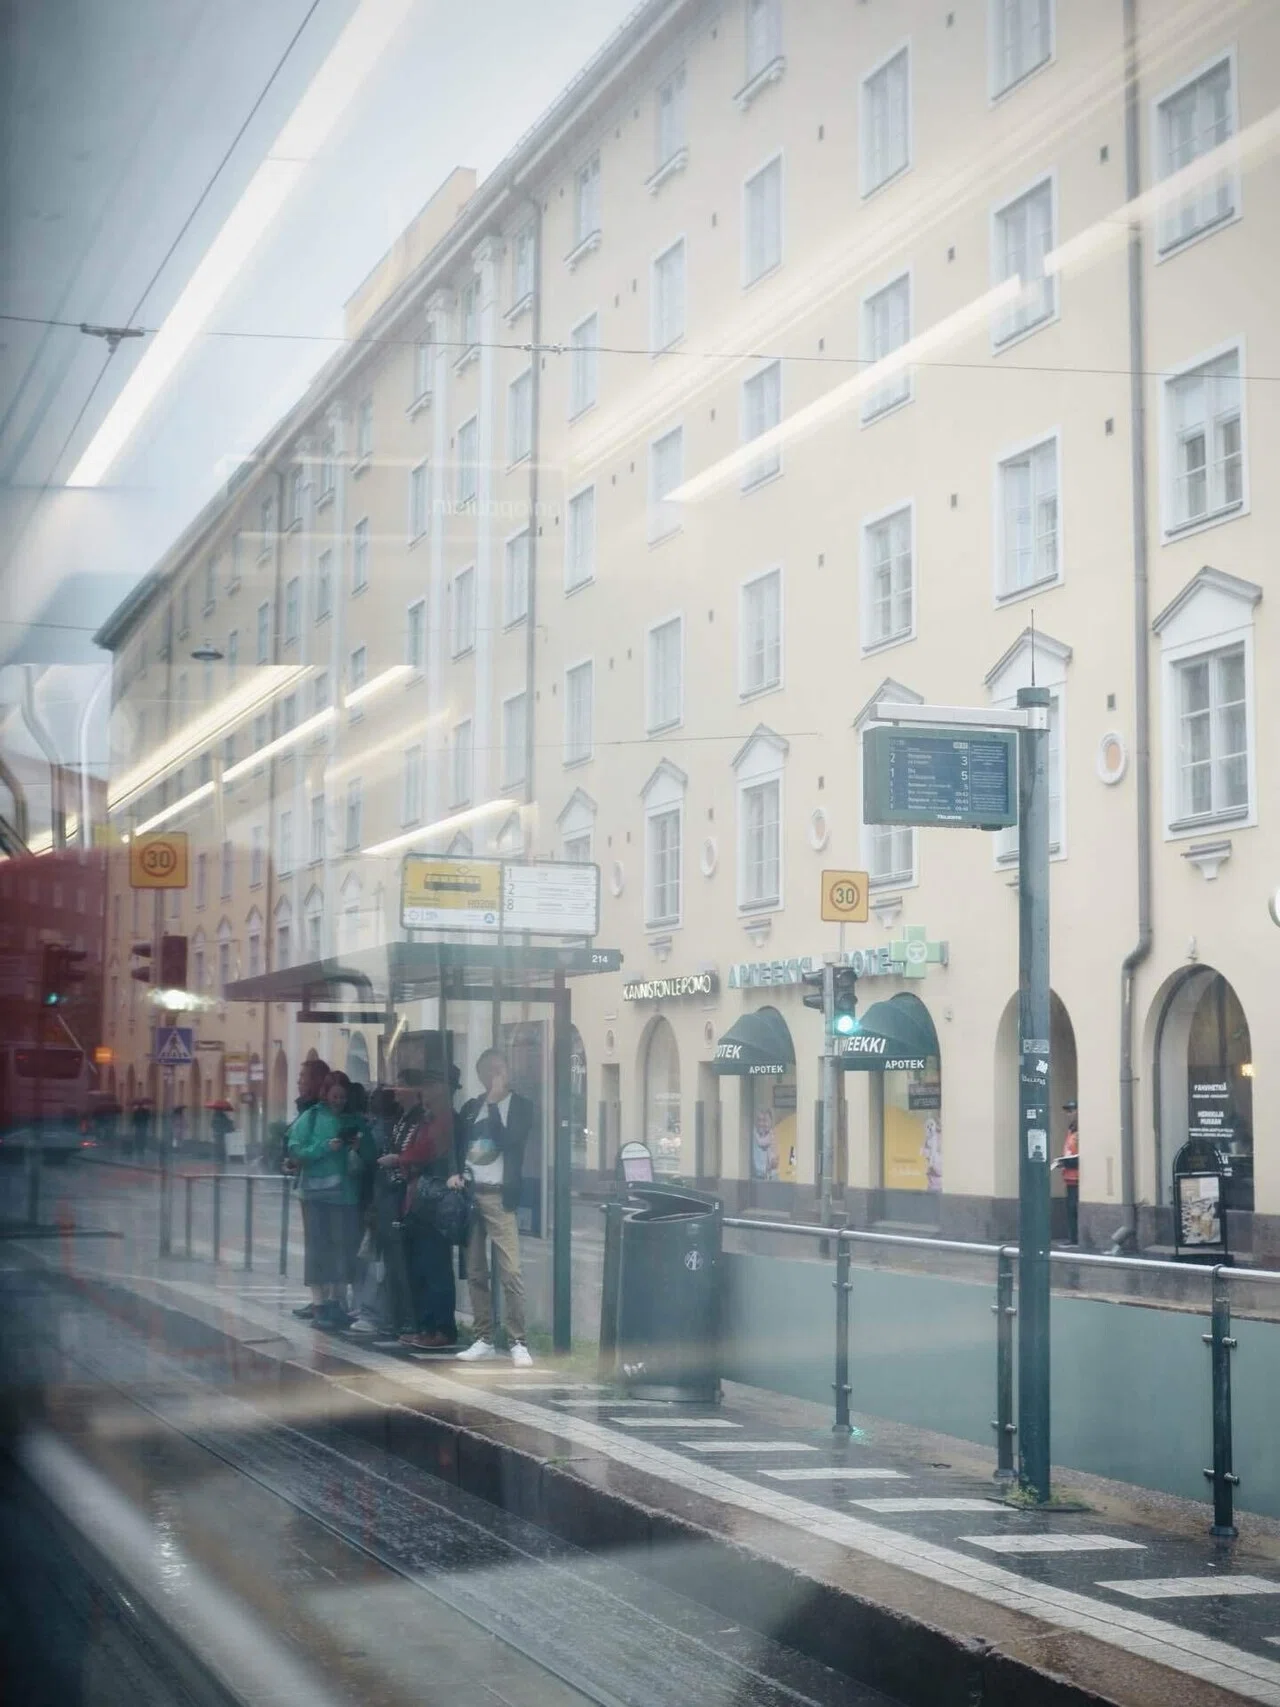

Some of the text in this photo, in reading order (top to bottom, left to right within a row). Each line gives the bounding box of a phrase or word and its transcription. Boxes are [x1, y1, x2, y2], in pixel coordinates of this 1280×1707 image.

[889, 753, 896, 763] 2
[961, 756, 968, 766] 3
[889, 768, 895, 778] 1
[961, 771, 968, 781] 5
[147, 850, 170, 869] 30
[507, 868, 512, 880] 1
[507, 883, 515, 895] 2
[835, 887, 855, 904] 30
[506, 898, 514, 911] 8
[592, 954, 608, 963] 214
[728, 956, 814, 988] APTEEKK
[715, 1044, 742, 1059] OTEK
[749, 1065, 784, 1074] APOTEK
[885, 1059, 925, 1070] APOTEK
